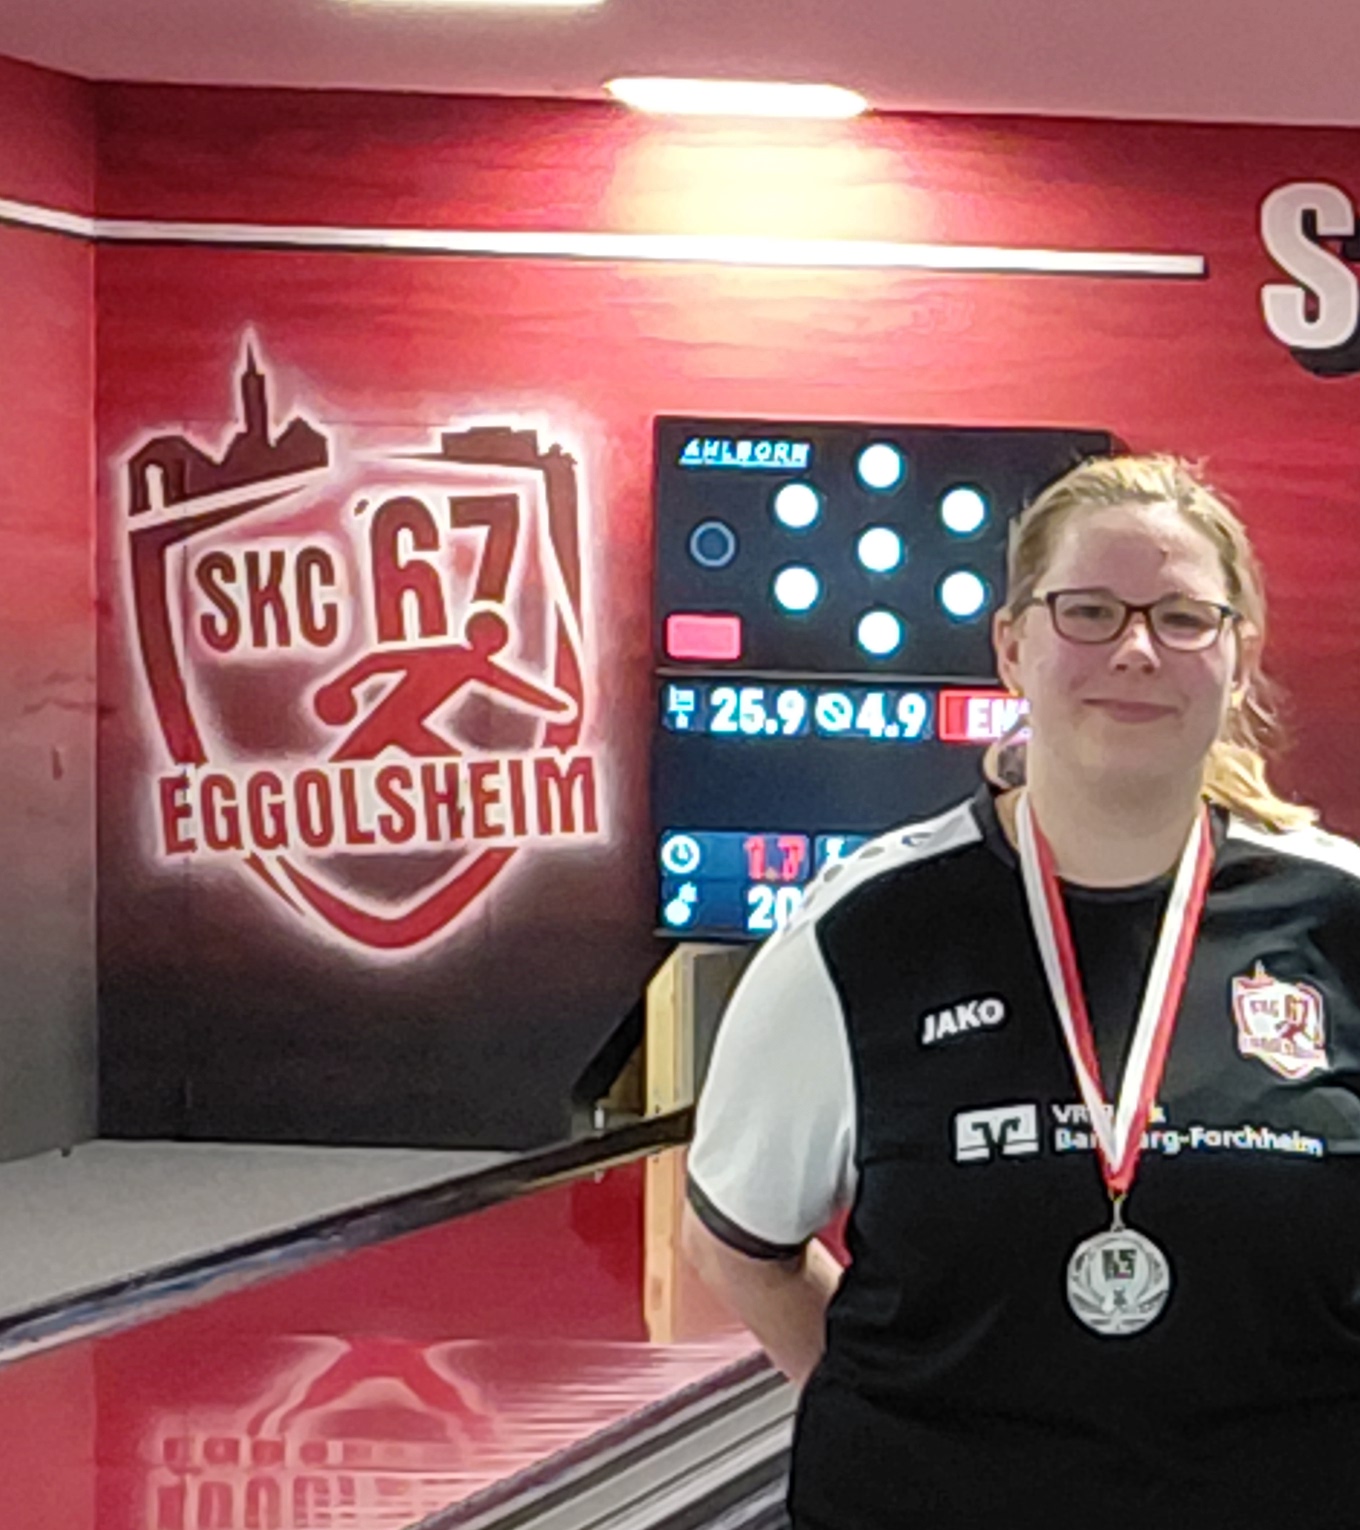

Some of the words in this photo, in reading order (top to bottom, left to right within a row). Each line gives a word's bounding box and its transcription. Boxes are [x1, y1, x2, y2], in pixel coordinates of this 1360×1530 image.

[195, 546, 338, 653] SKC
[709, 686, 806, 735] 25.9
[855, 692, 928, 738] 4.9
[967, 698, 1031, 738] EN
[158, 754, 599, 856] EGGOLSHEIM
[747, 884, 804, 931] 20
[921, 997, 1005, 1046] JAKO
